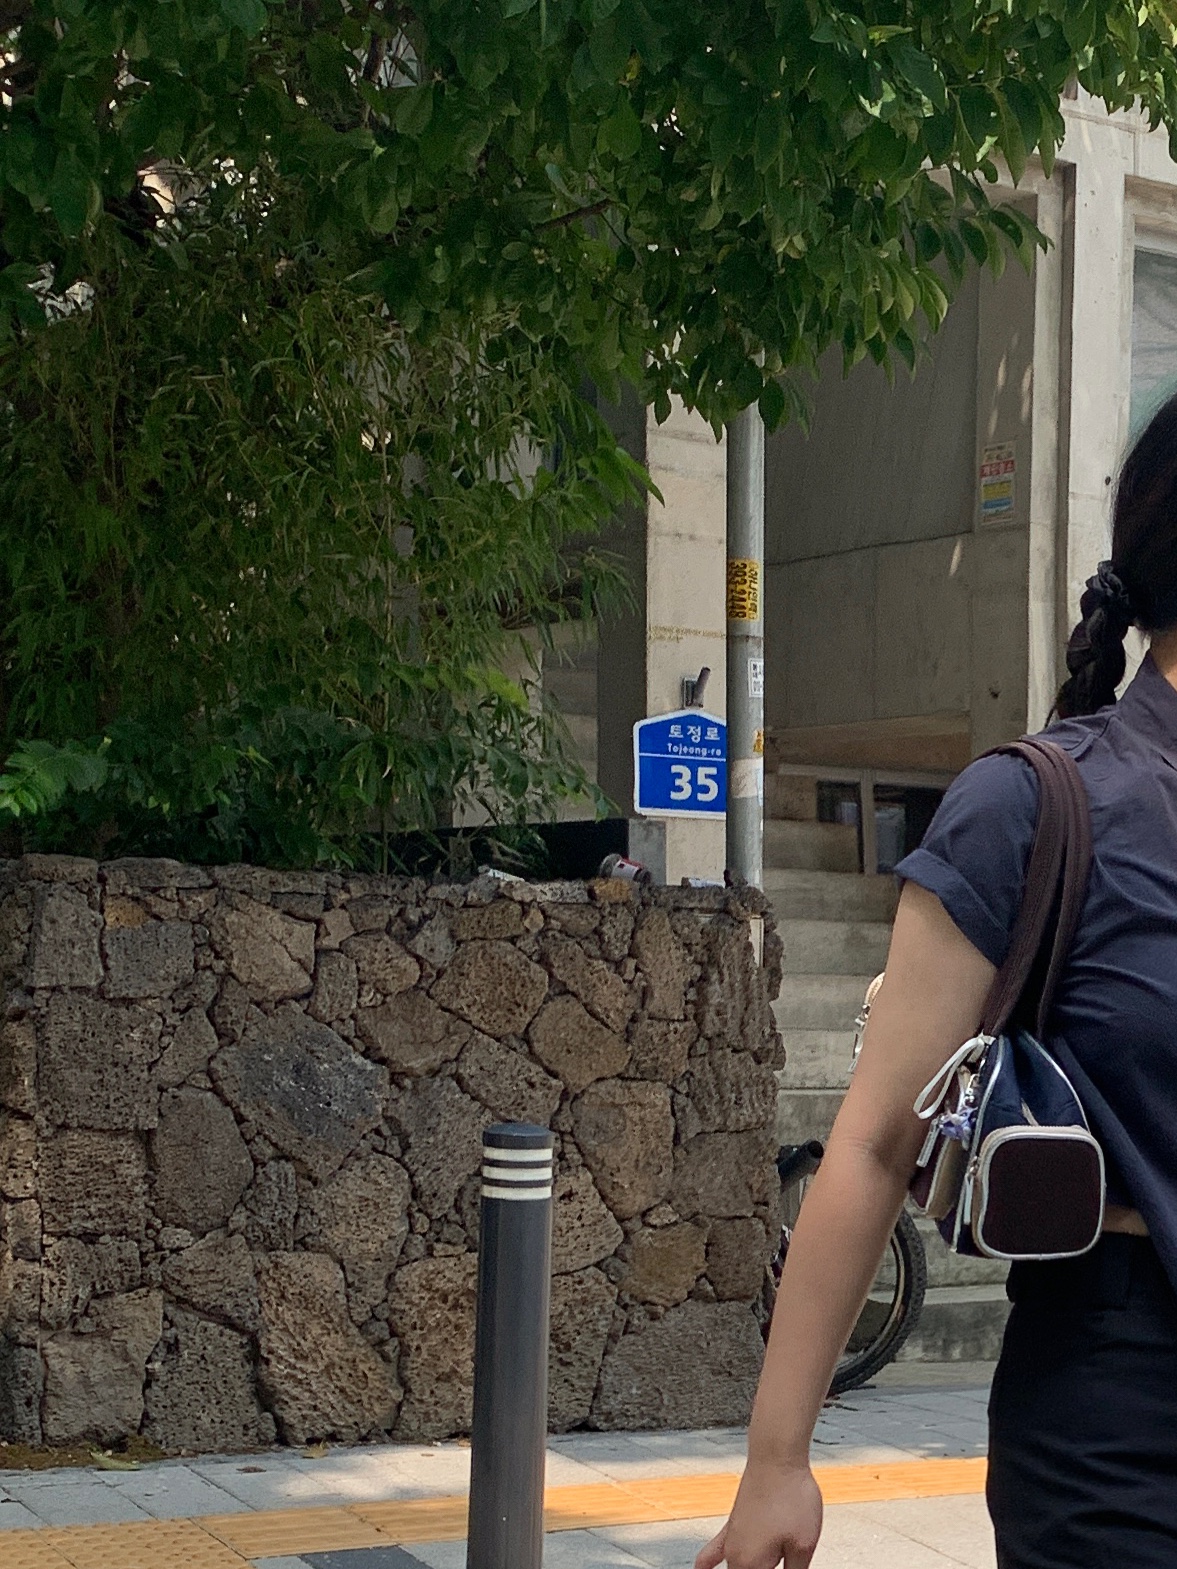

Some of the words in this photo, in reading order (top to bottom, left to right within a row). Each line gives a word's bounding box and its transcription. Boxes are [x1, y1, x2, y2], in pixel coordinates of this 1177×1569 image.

[668, 724, 721, 744] 토정로
[667, 743, 722, 757] Tojeong-ro
[670, 764, 719, 802] 35
